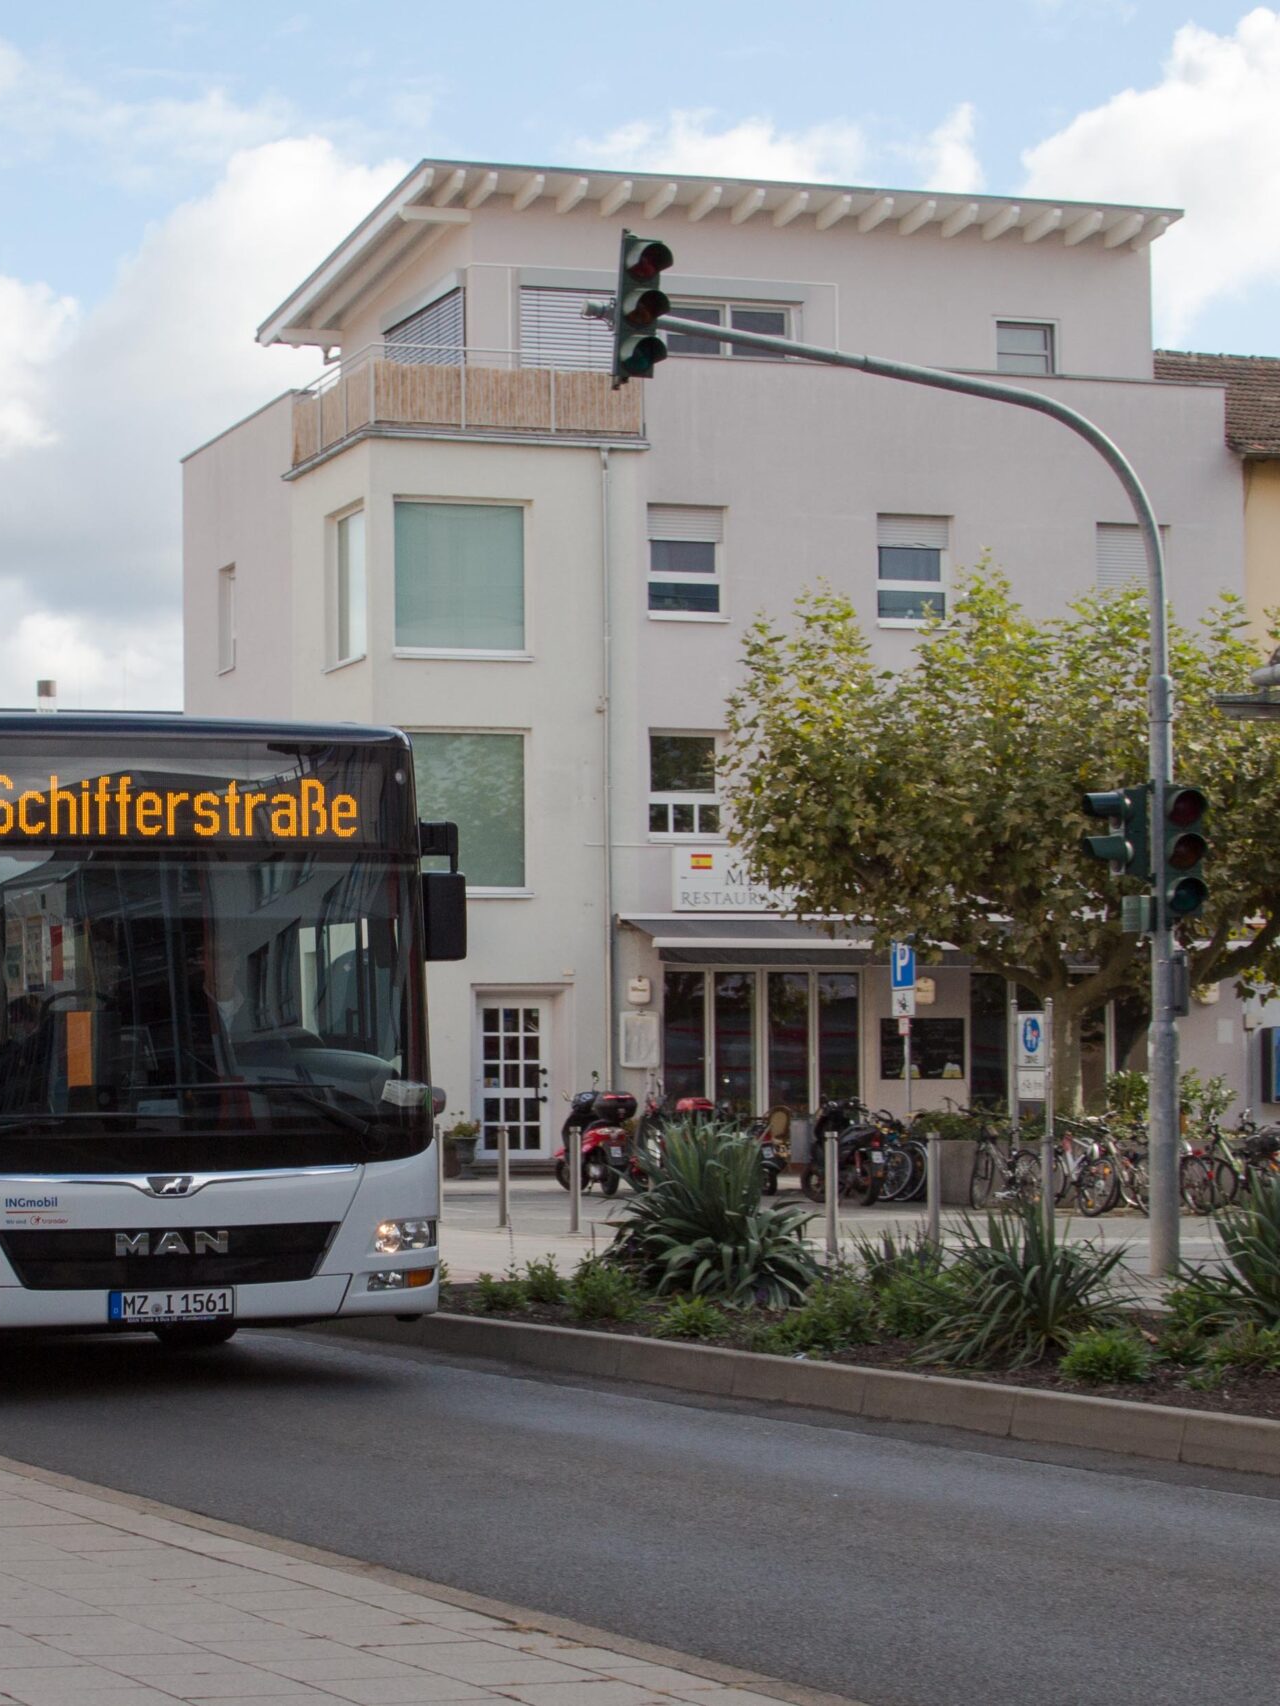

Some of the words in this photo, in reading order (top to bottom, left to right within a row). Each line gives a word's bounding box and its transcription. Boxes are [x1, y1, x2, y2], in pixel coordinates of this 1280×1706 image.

[896, 942, 910, 982] P
[5, 1197, 58, 1208] INGmobil
[115, 1231, 229, 1256] MAN
[123, 1295, 150, 1315] MZ
[164, 1295, 174, 1314] I
[181, 1293, 229, 1314] 1561
